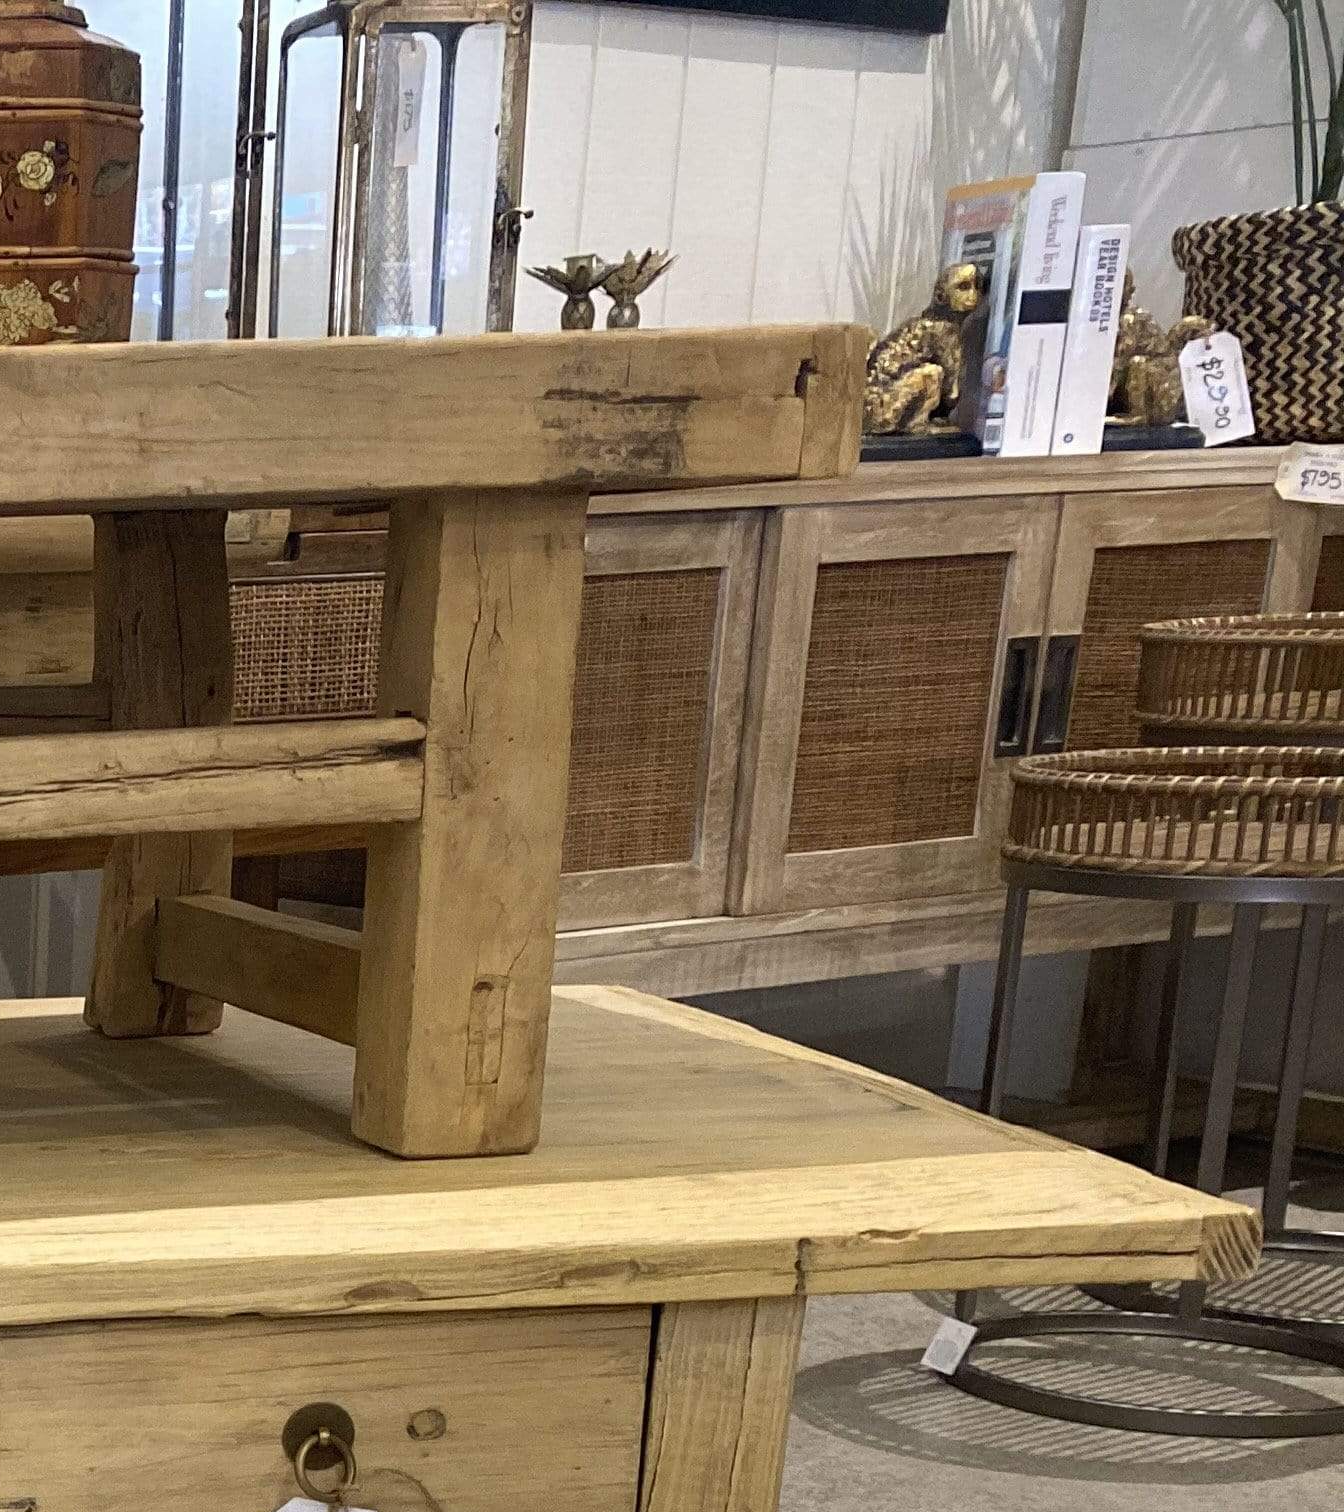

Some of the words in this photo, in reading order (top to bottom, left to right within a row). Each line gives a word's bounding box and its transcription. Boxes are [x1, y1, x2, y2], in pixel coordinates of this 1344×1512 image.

[1097, 239, 1110, 270] YEAR
[1105, 238, 1121, 283] DESIGN
[1099, 287, 1114, 333] HOTELS
[1300, 469, 1342, 493] $795
